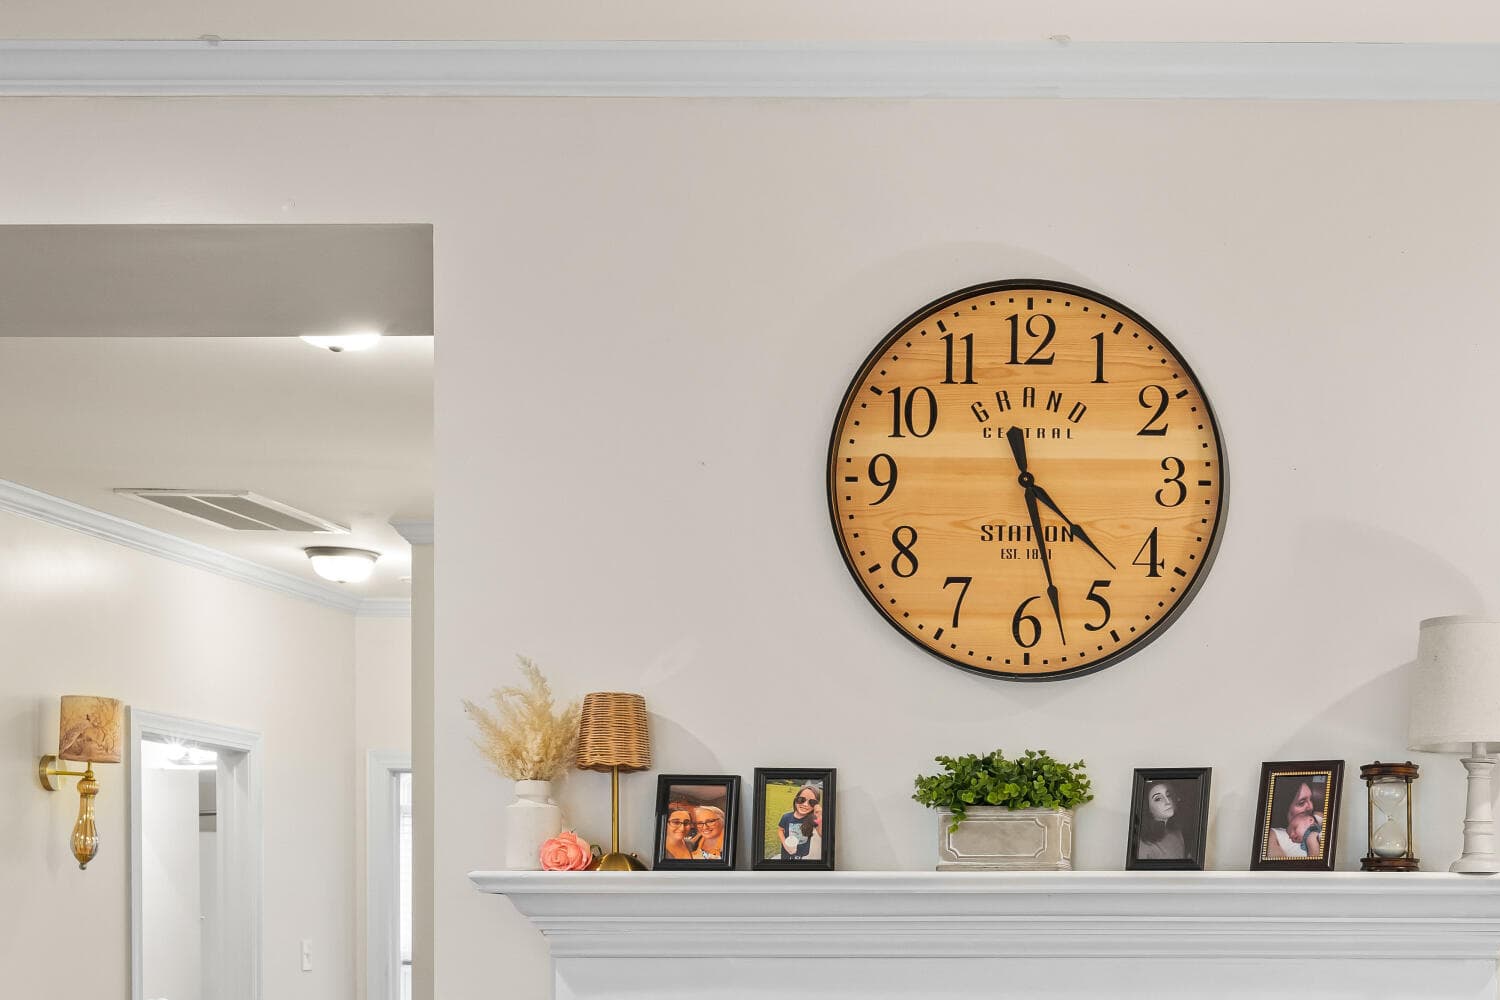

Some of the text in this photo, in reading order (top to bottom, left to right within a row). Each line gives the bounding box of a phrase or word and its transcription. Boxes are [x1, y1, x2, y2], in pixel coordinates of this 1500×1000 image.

[939, 332, 979, 385] 11
[1004, 313, 1056, 366] 12
[1090, 332, 1109, 384] 1
[887, 386, 938, 438] 10
[970, 386, 1087, 424] GRAND
[1136, 384, 1170, 437] 2
[983, 427, 1073, 439] CETRAL
[867, 453, 898, 506] 9
[1155, 456, 1187, 508] 3
[891, 525, 919, 578] 8
[980, 524, 1075, 543] STATON
[1001, 548, 1052, 560] EST. 181
[1132, 526, 1165, 578] 4
[942, 576, 973, 629] 7
[1011, 595, 1042, 649] 6
[1084, 580, 1113, 632] 5
